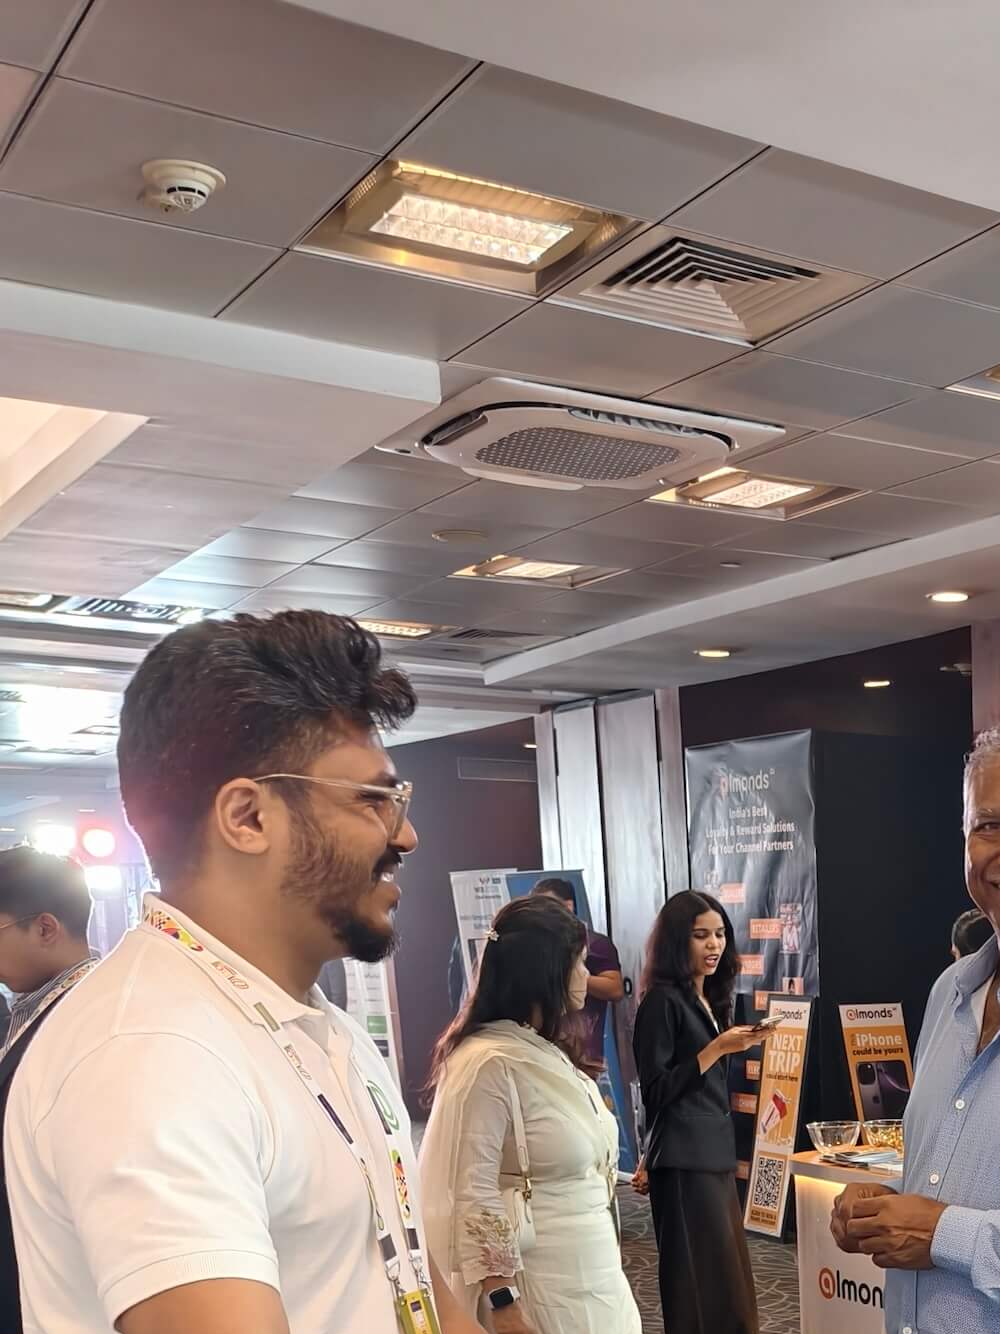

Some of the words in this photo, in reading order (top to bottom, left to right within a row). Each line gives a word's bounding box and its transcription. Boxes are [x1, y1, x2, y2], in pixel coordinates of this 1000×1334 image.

[729, 807, 750, 820] India's
[752, 805, 768, 818] Best
[763, 821, 796, 834] Solutions
[736, 841, 762, 853] Channel
[763, 840, 794, 852] Partners
[772, 1032, 803, 1052] NEXT
[855, 1033, 902, 1047] iPhone
[768, 1050, 800, 1073] TRIP
[819, 1268, 884, 1309] almon
